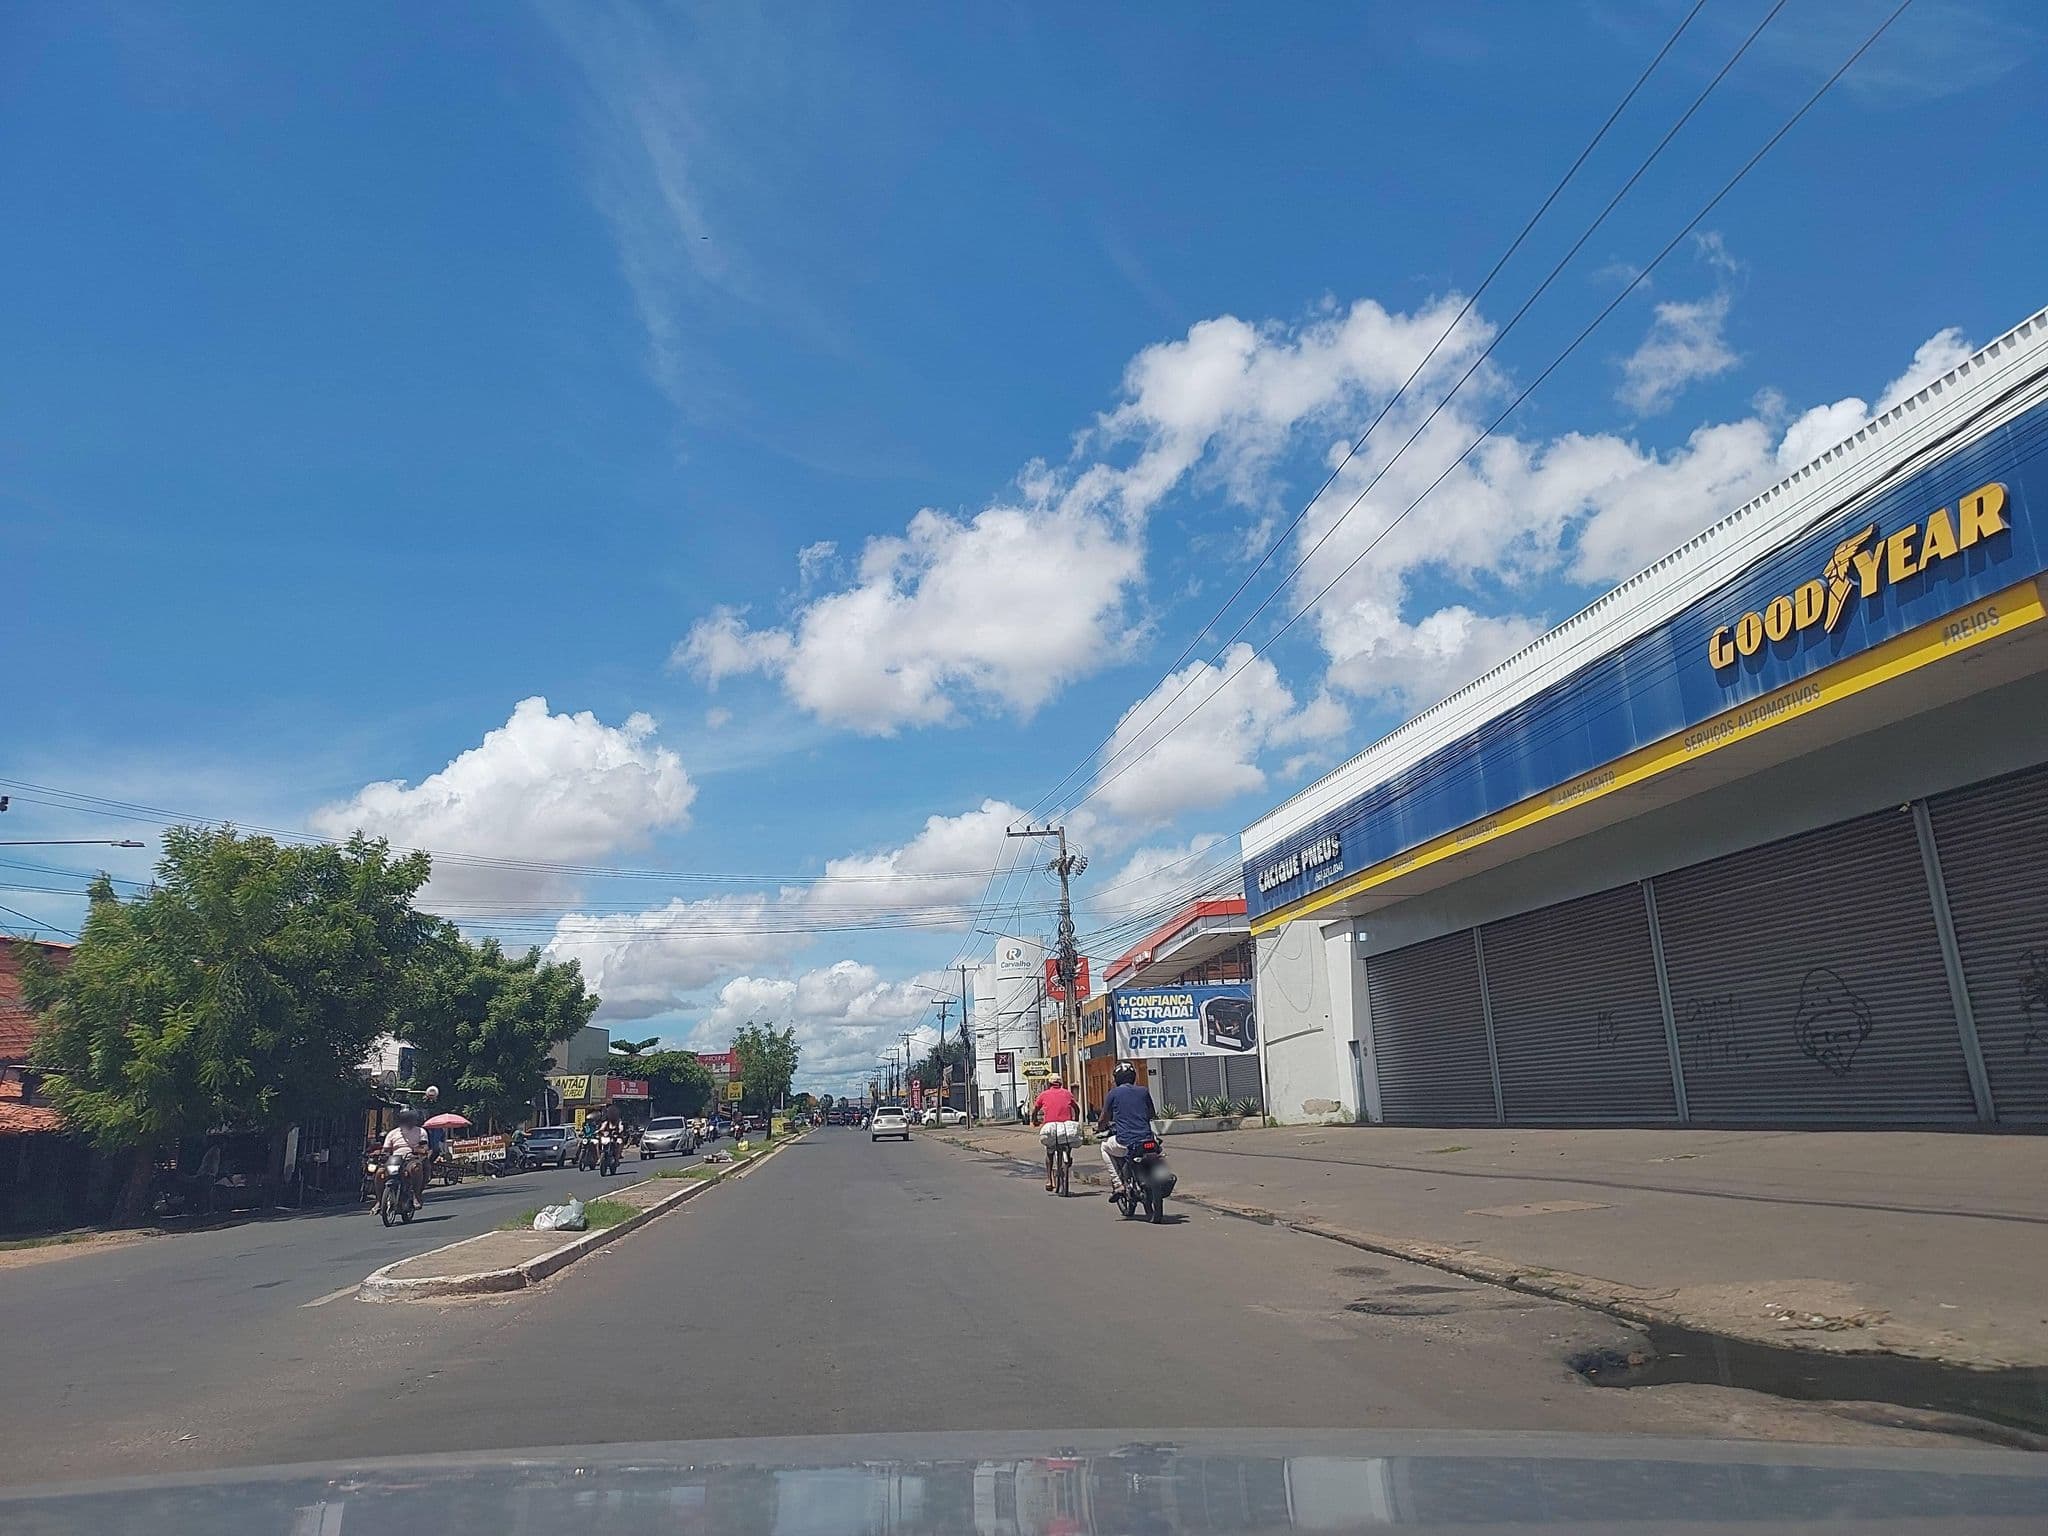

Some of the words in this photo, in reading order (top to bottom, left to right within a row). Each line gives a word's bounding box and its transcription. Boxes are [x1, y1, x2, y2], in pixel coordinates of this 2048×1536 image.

[1684, 719, 1735, 753] SERVIÇOS
[1738, 683, 1821, 731] AUTOMOTIVOS
[1551, 770, 1615, 805] LANCEAMENTO
[1259, 853, 1300, 893] CACIQUE
[1301, 834, 1340, 871] PNEUS
[1129, 994, 1194, 1007] CONFIANÇA
[1131, 1006, 1194, 1019] ESTRADA!
[1131, 1027, 1171, 1035] BATERIAS
[1129, 1035, 1187, 1049] OFERTA
[556, 1077, 585, 1088] ANTÃO
